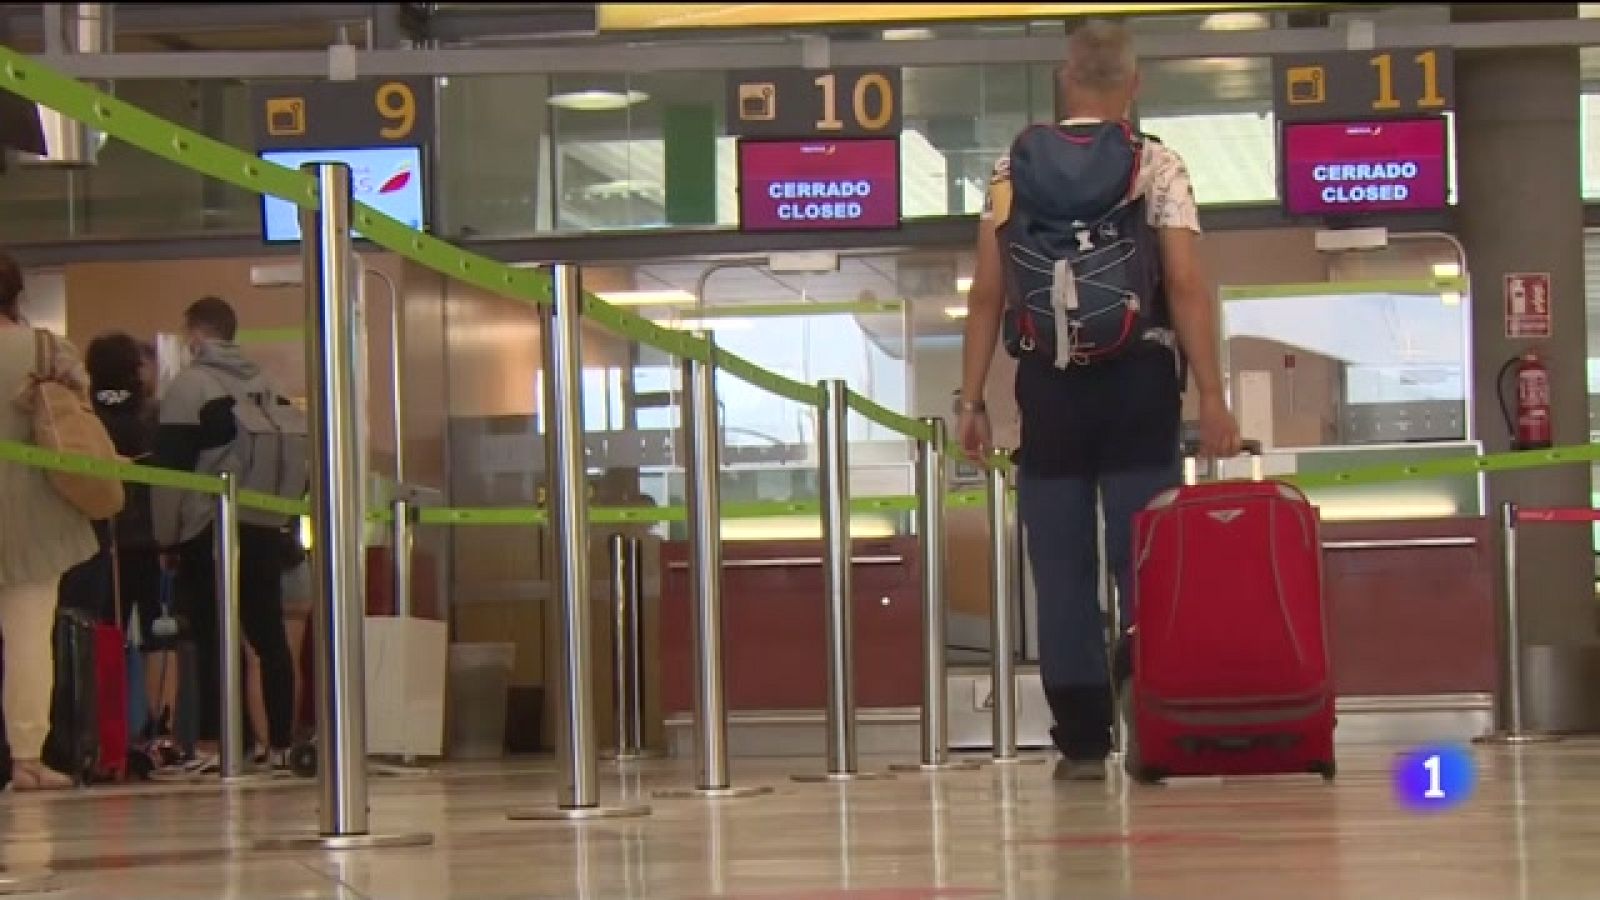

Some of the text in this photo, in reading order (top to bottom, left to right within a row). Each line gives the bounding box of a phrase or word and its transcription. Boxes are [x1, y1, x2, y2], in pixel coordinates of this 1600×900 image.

[1369, 51, 1446, 109] 11
[375, 81, 416, 139] 9
[814, 74, 893, 130] 10
[1313, 162, 1416, 181] CERRADO
[769, 181, 871, 199] CERRADO
[1322, 185, 1409, 203] CLOSED
[777, 203, 862, 219] CLOSED
